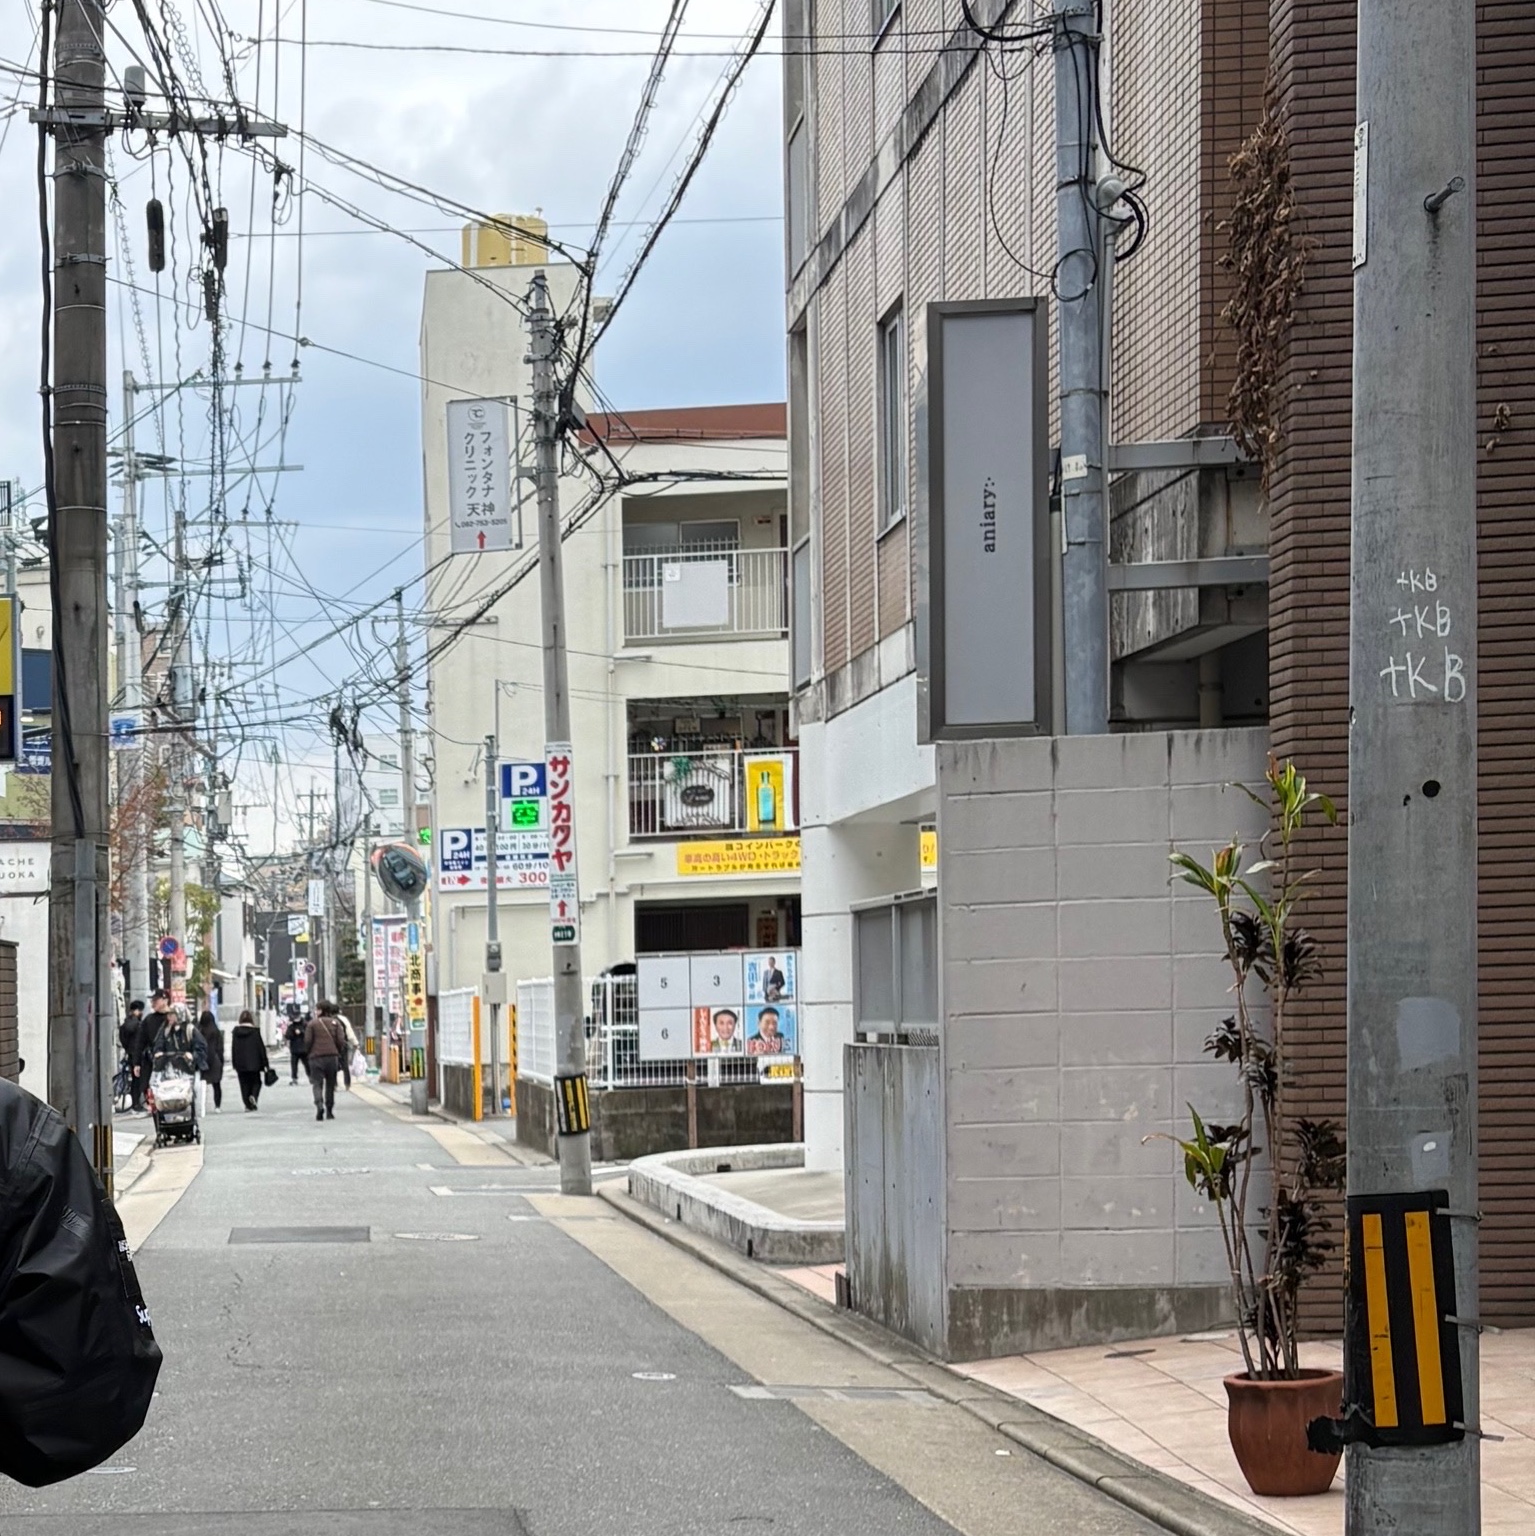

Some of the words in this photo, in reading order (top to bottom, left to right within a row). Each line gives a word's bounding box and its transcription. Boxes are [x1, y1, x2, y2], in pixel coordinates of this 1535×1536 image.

[464, 432, 477, 499] クリニック
[480, 431, 494, 498] フォンタナ
[467, 502, 495, 517] 天神
[510, 765, 538, 796] P
[521, 786, 540, 795] 24H
[549, 755, 573, 872] サンカクヤ
[442, 830, 468, 860] P
[519, 872, 547, 884] 300
[660, 977, 668, 989] 5
[713, 975, 721, 987] 3
[661, 1028, 669, 1040] 6
